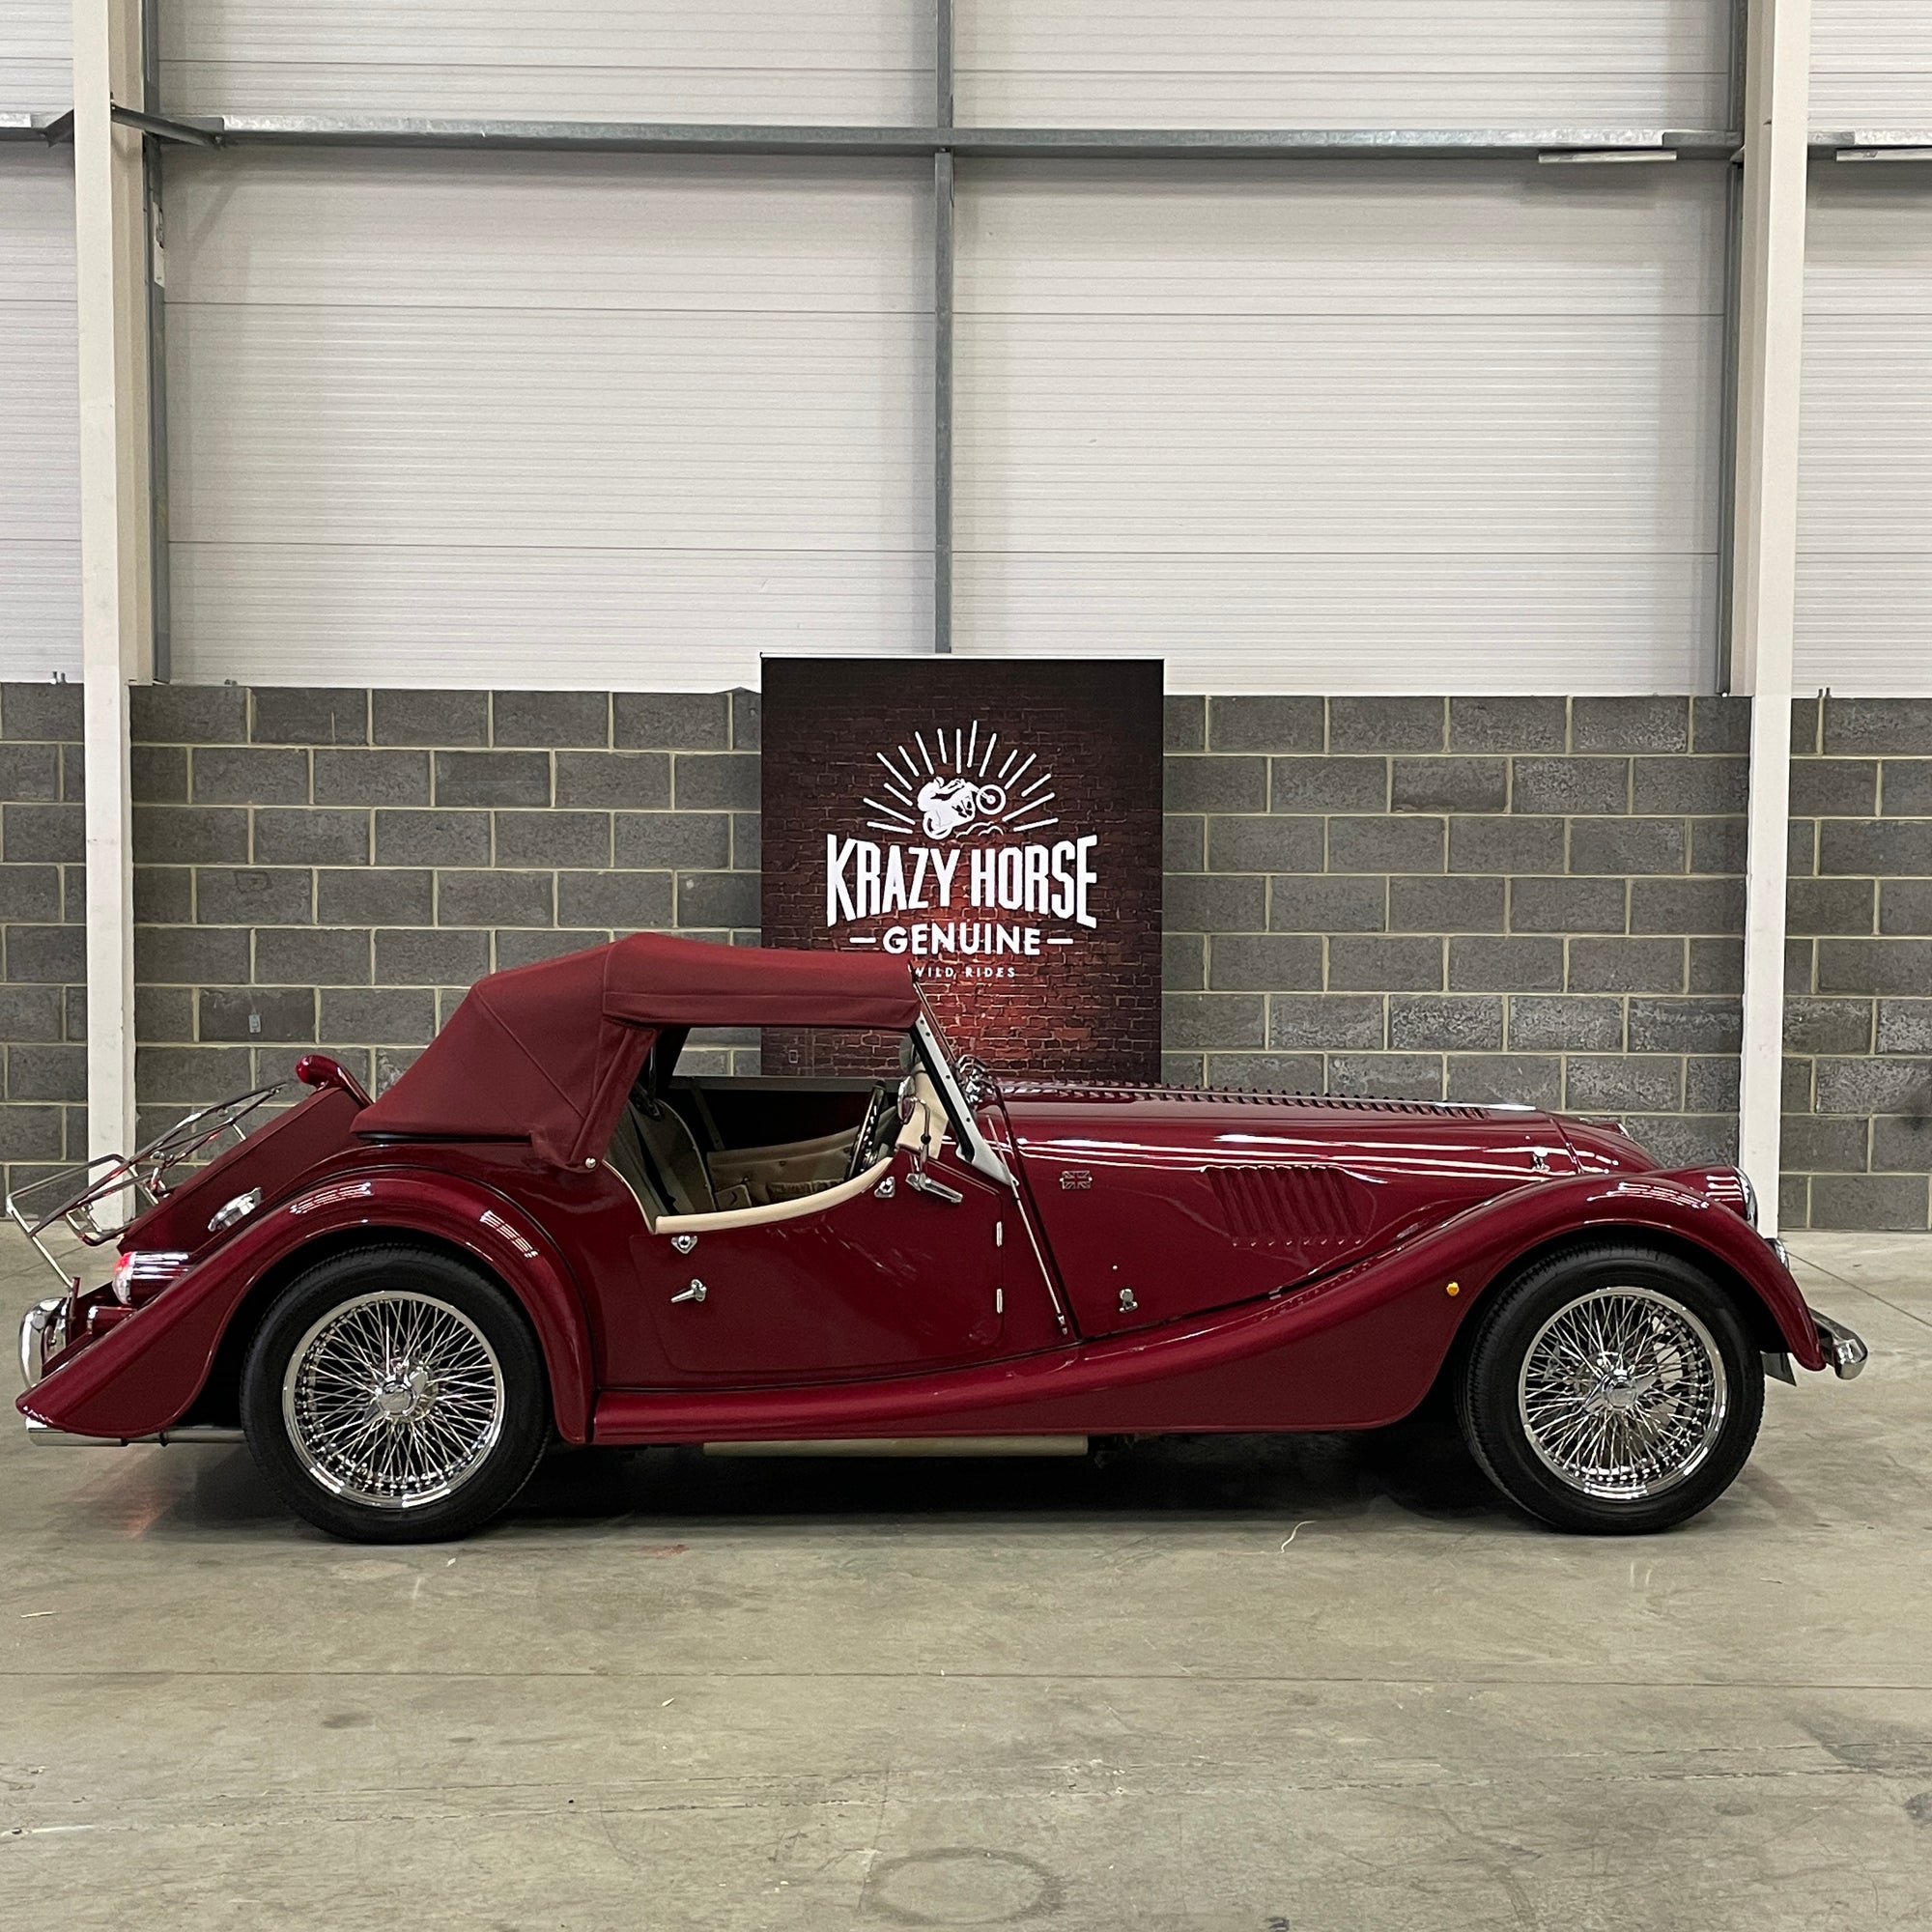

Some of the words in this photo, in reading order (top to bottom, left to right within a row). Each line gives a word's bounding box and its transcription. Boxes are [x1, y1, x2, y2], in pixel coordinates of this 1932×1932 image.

[827, 834, 960, 927] KRAZY
[971, 835, 1097, 929] HORSE
[882, 922, 1040, 955] GENUINE
[965, 966, 1015, 979] RIDES
